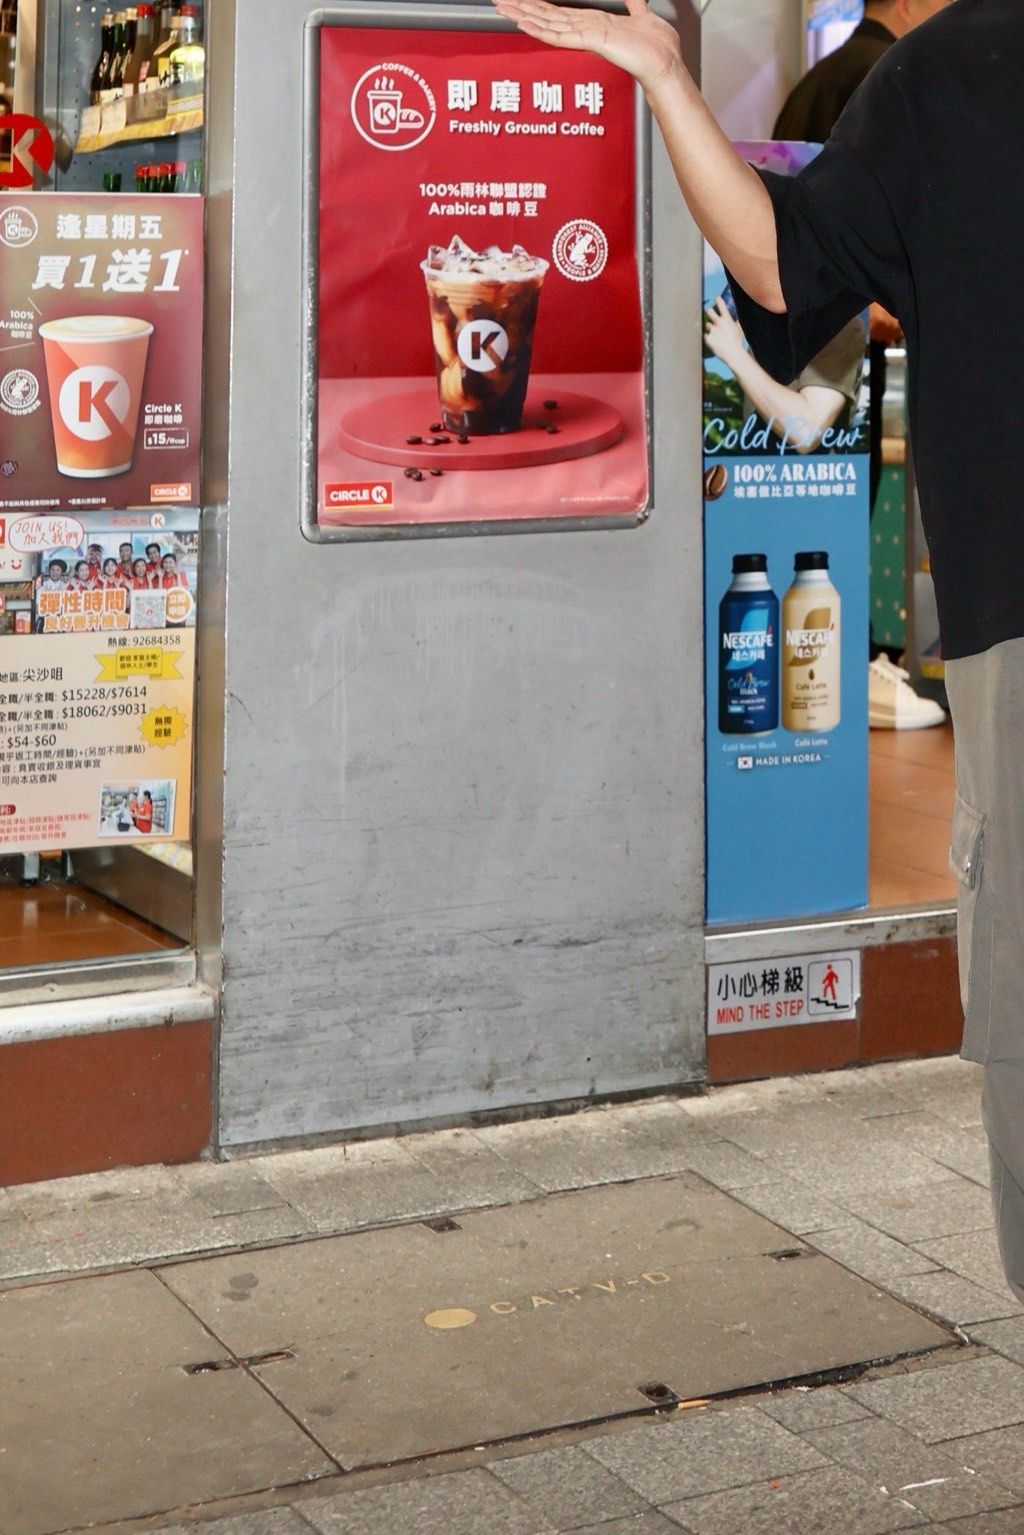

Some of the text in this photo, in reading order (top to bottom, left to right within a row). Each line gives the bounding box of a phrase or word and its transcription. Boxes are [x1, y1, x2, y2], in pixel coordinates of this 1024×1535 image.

[382, 63, 415, 78] COFFEE
[418, 77, 437, 112] BAKERY
[447, 79, 604, 115] 即磨咖啡
[449, 119, 605, 136] Freshly Ground Coffee
[419, 182, 547, 199] 100%雨林聯盟認證
[428, 200, 539, 216] Arabica 咖啡豆
[56, 213, 163, 240] 逢星期五
[10, 310, 35, 319] 100%
[144, 404, 182, 414] Circle K
[703, 413, 865, 456] Cold Brew
[734, 462, 856, 482] 100% ARABICA
[154, 488, 177, 496] CIRCLE
[330, 486, 388, 503] CIRCLE K
[15, 521, 42, 534] JOIN
[38, 588, 127, 615] 彈性時間
[132, 635, 181, 646] 92684358
[62, 685, 148, 703] $15228/$7614
[62, 703, 148, 719] $18062/$9031
[7, 734, 57, 749] $54-$60
[755, 754, 821, 766] MADE IN KOREA
[717, 966, 804, 1001] 小心梯級
[716, 1000, 804, 1025] MIND THE STEP
